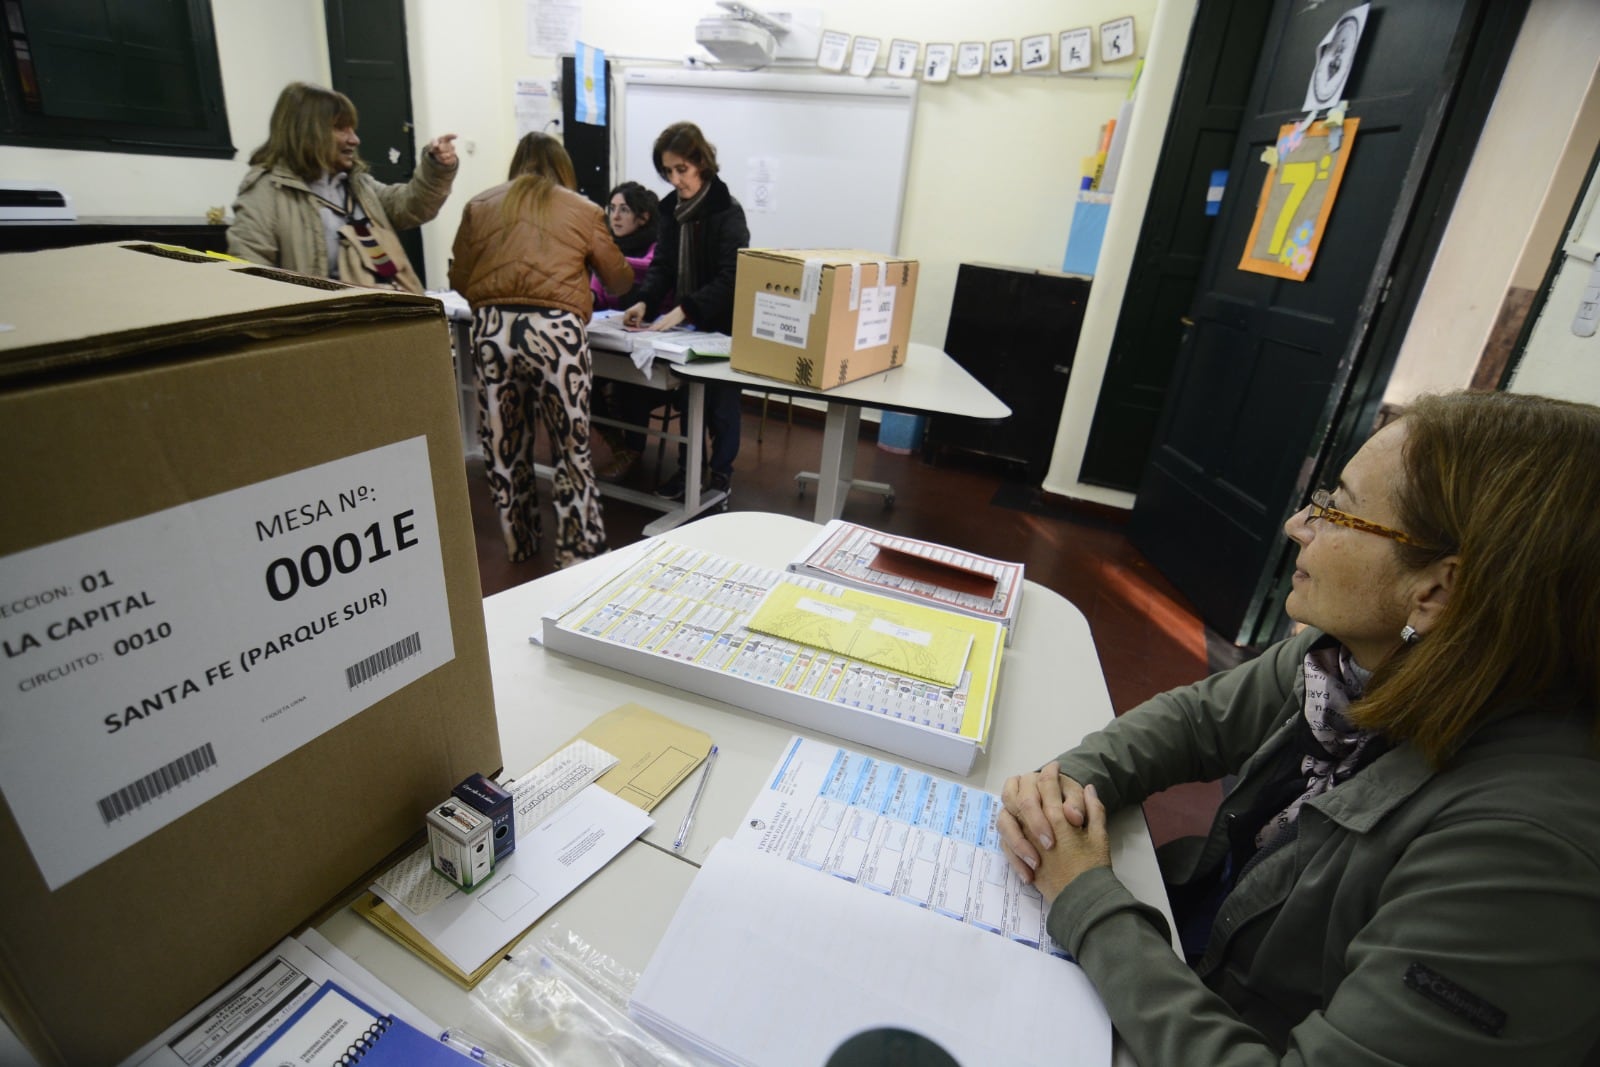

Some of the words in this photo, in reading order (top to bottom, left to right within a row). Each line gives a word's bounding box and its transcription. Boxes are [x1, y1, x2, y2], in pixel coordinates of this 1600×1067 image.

[255, 499, 333, 542] MESA
[265, 509, 419, 602] 0001E
[0, 586, 74, 620] ECCION:
[80, 569, 114, 593] 01
[3, 633, 41, 658] LA
[47, 591, 156, 641] CAPITAL
[18, 652, 104, 692] CIRCUITO:
[113, 622, 172, 656] 0010
[104, 678, 200, 734] SANTA
[205, 660, 234, 687] FE
[240, 612, 340, 672] (PARQUE
[343, 588, 388, 620] SUR)
